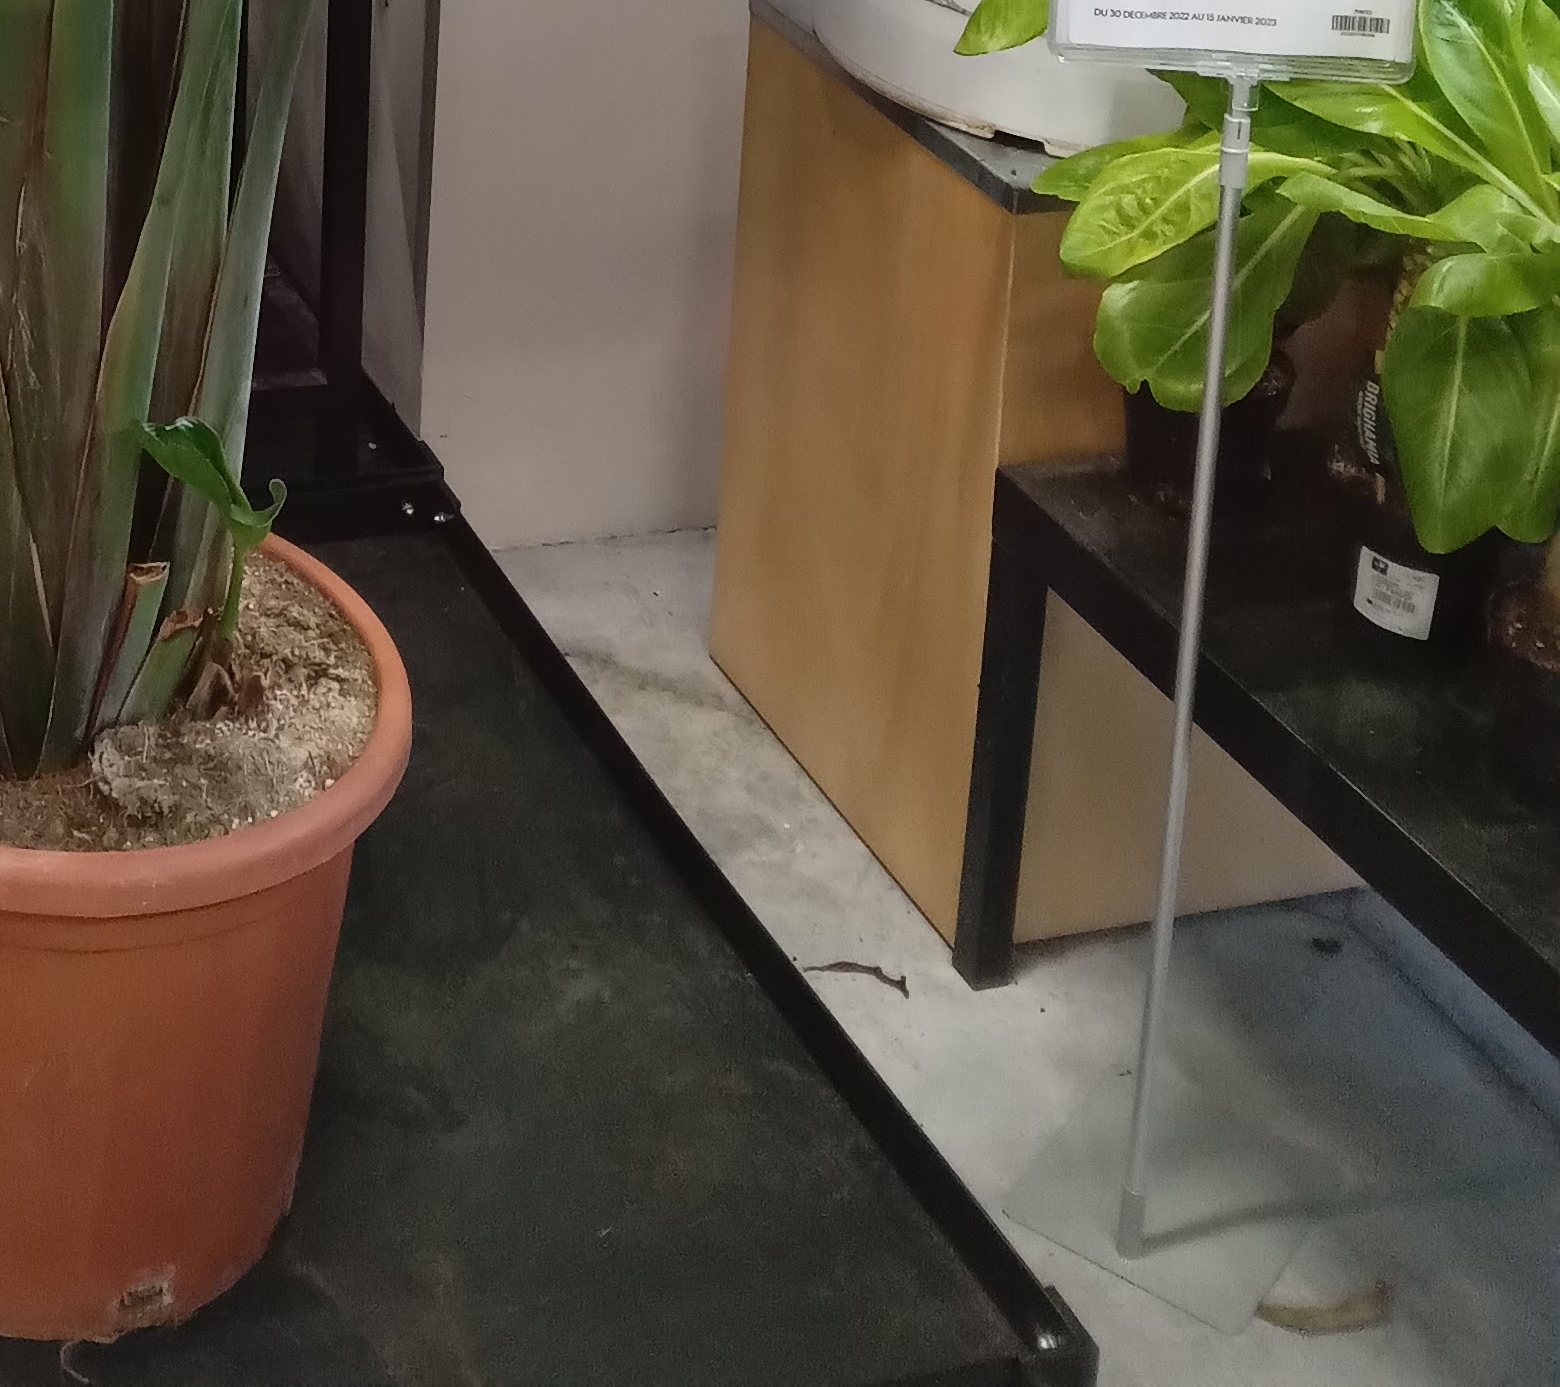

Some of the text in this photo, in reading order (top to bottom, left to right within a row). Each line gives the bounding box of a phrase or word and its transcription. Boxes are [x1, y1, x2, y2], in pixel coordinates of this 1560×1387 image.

[1093, 7, 1109, 17] DU
[1110, 8, 1122, 18] 30
[1169, 11, 1190, 21] 2022
[1190, 13, 1206, 22] AU
[1206, 13, 1215, 22] 15
[1216, 14, 1254, 25] JANVIER
[1254, 16, 1278, 27] 2023
